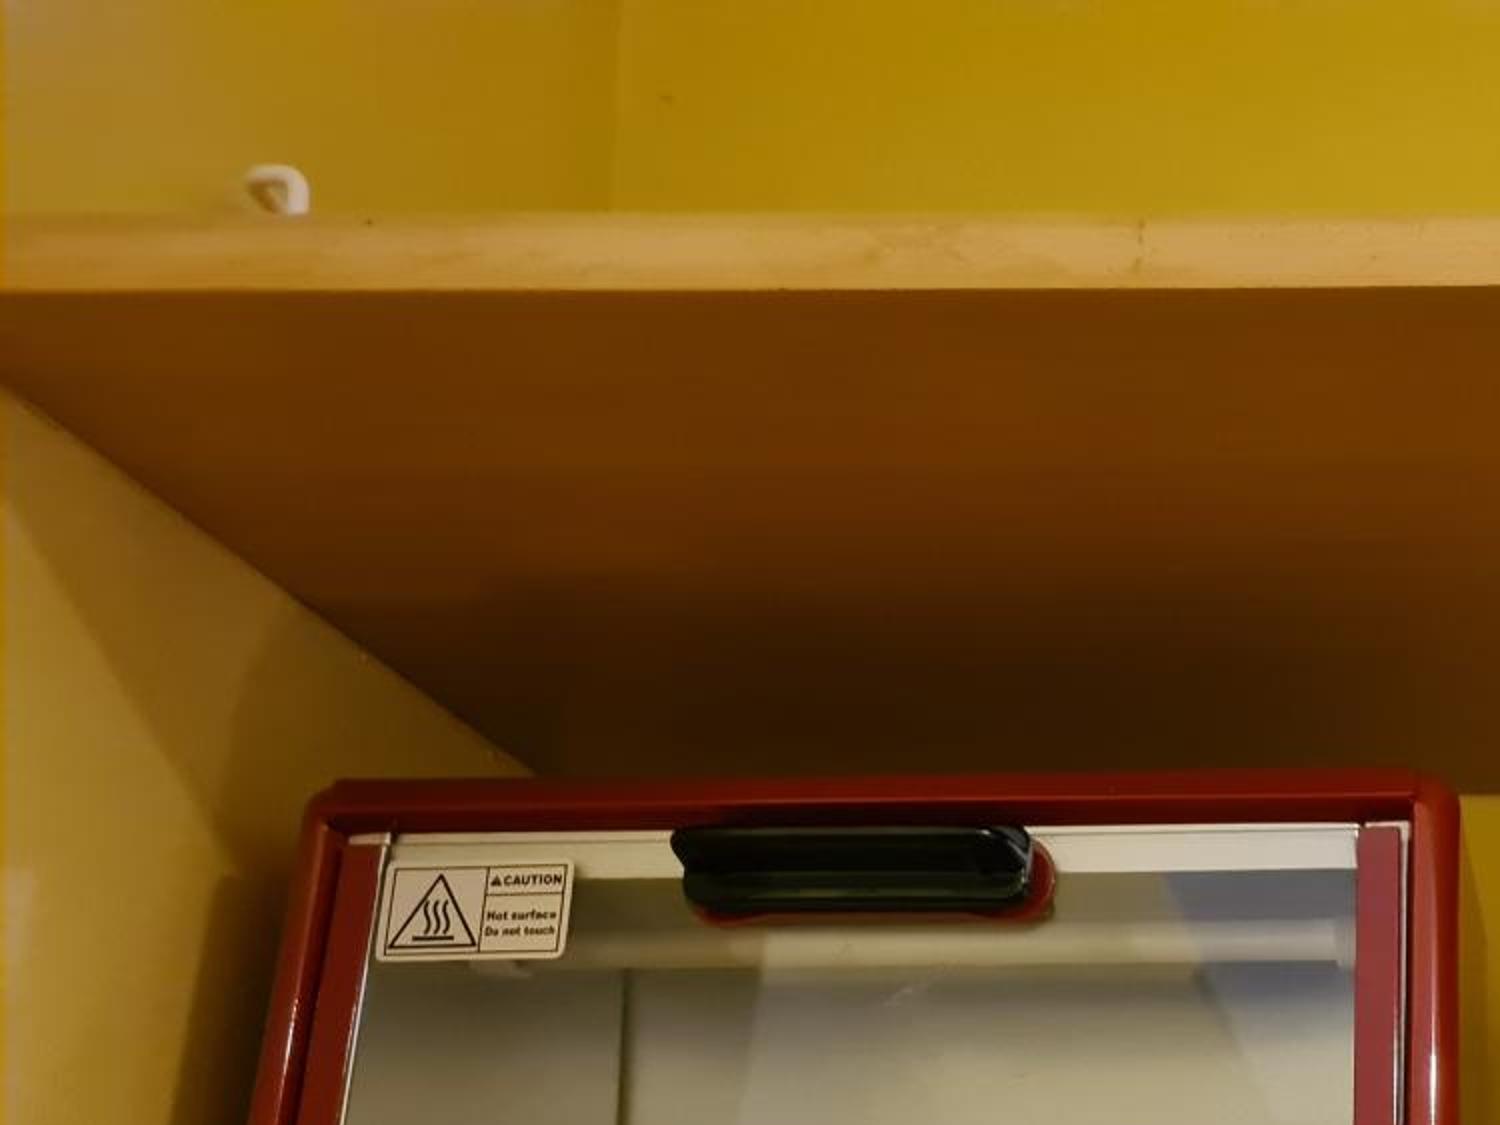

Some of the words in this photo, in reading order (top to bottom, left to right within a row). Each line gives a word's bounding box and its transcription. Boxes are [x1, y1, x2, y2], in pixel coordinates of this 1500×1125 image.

[503, 874, 562, 886] CAUTION
[487, 911, 508, 921] Hot
[511, 909, 557, 920] surface
[485, 926, 499, 936] Do
